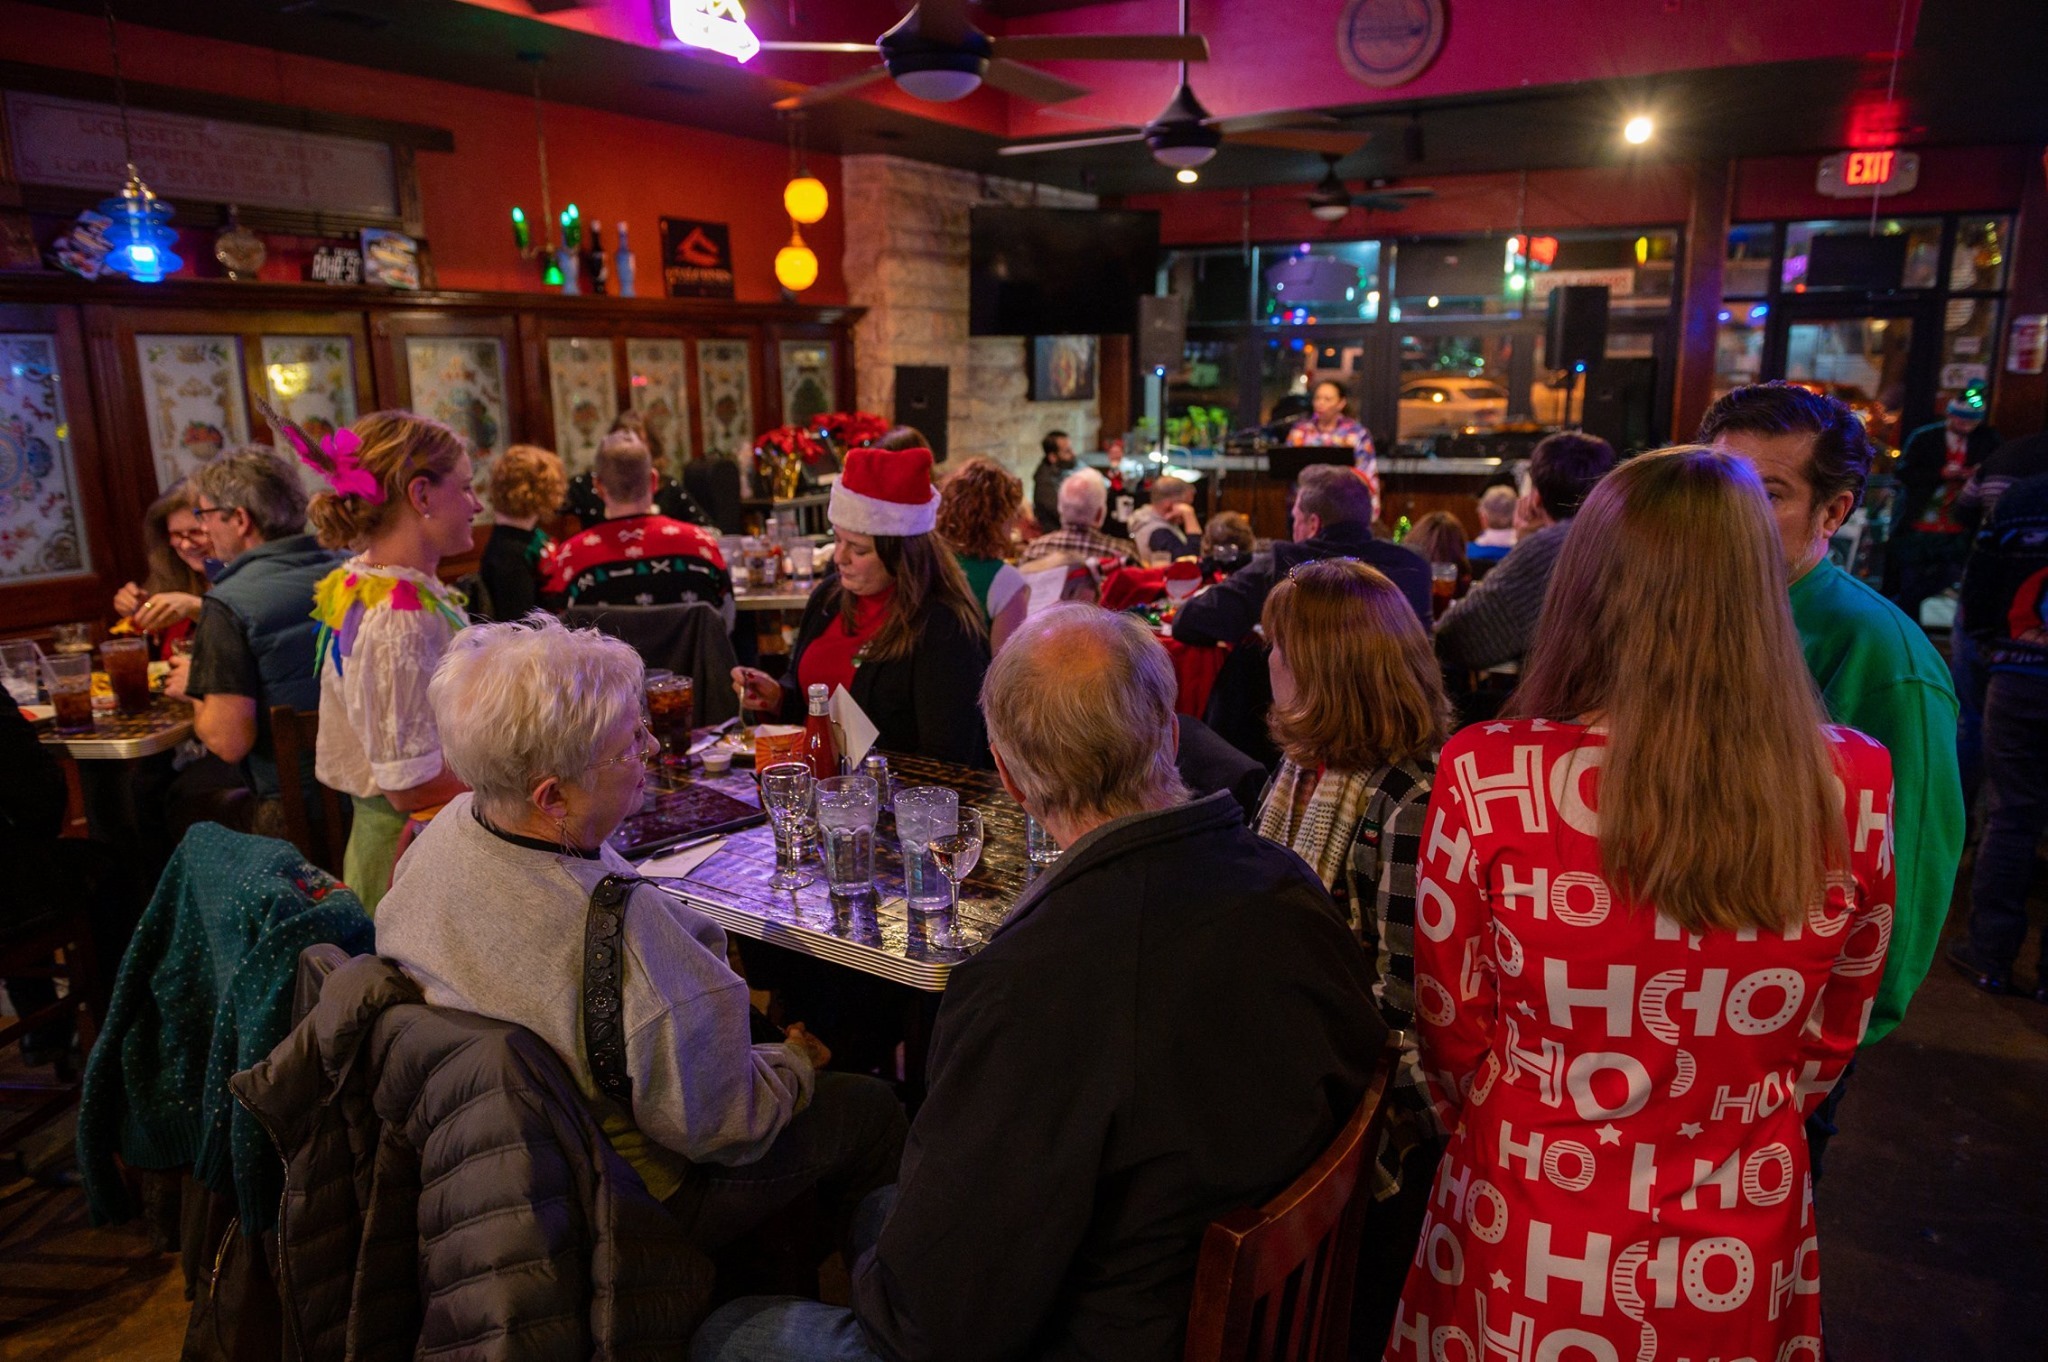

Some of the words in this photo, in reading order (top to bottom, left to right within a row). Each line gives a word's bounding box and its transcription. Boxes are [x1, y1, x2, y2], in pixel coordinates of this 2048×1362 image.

[1847, 151, 1894, 185] EXIT
[1501, 864, 1611, 926] HO
[1502, 1013, 1652, 1121] HO
[1710, 1071, 1784, 1123] HO
[1499, 1120, 1595, 1191] HO
[1681, 1142, 1793, 1207] HO
[1438, 1153, 1508, 1244] HO
